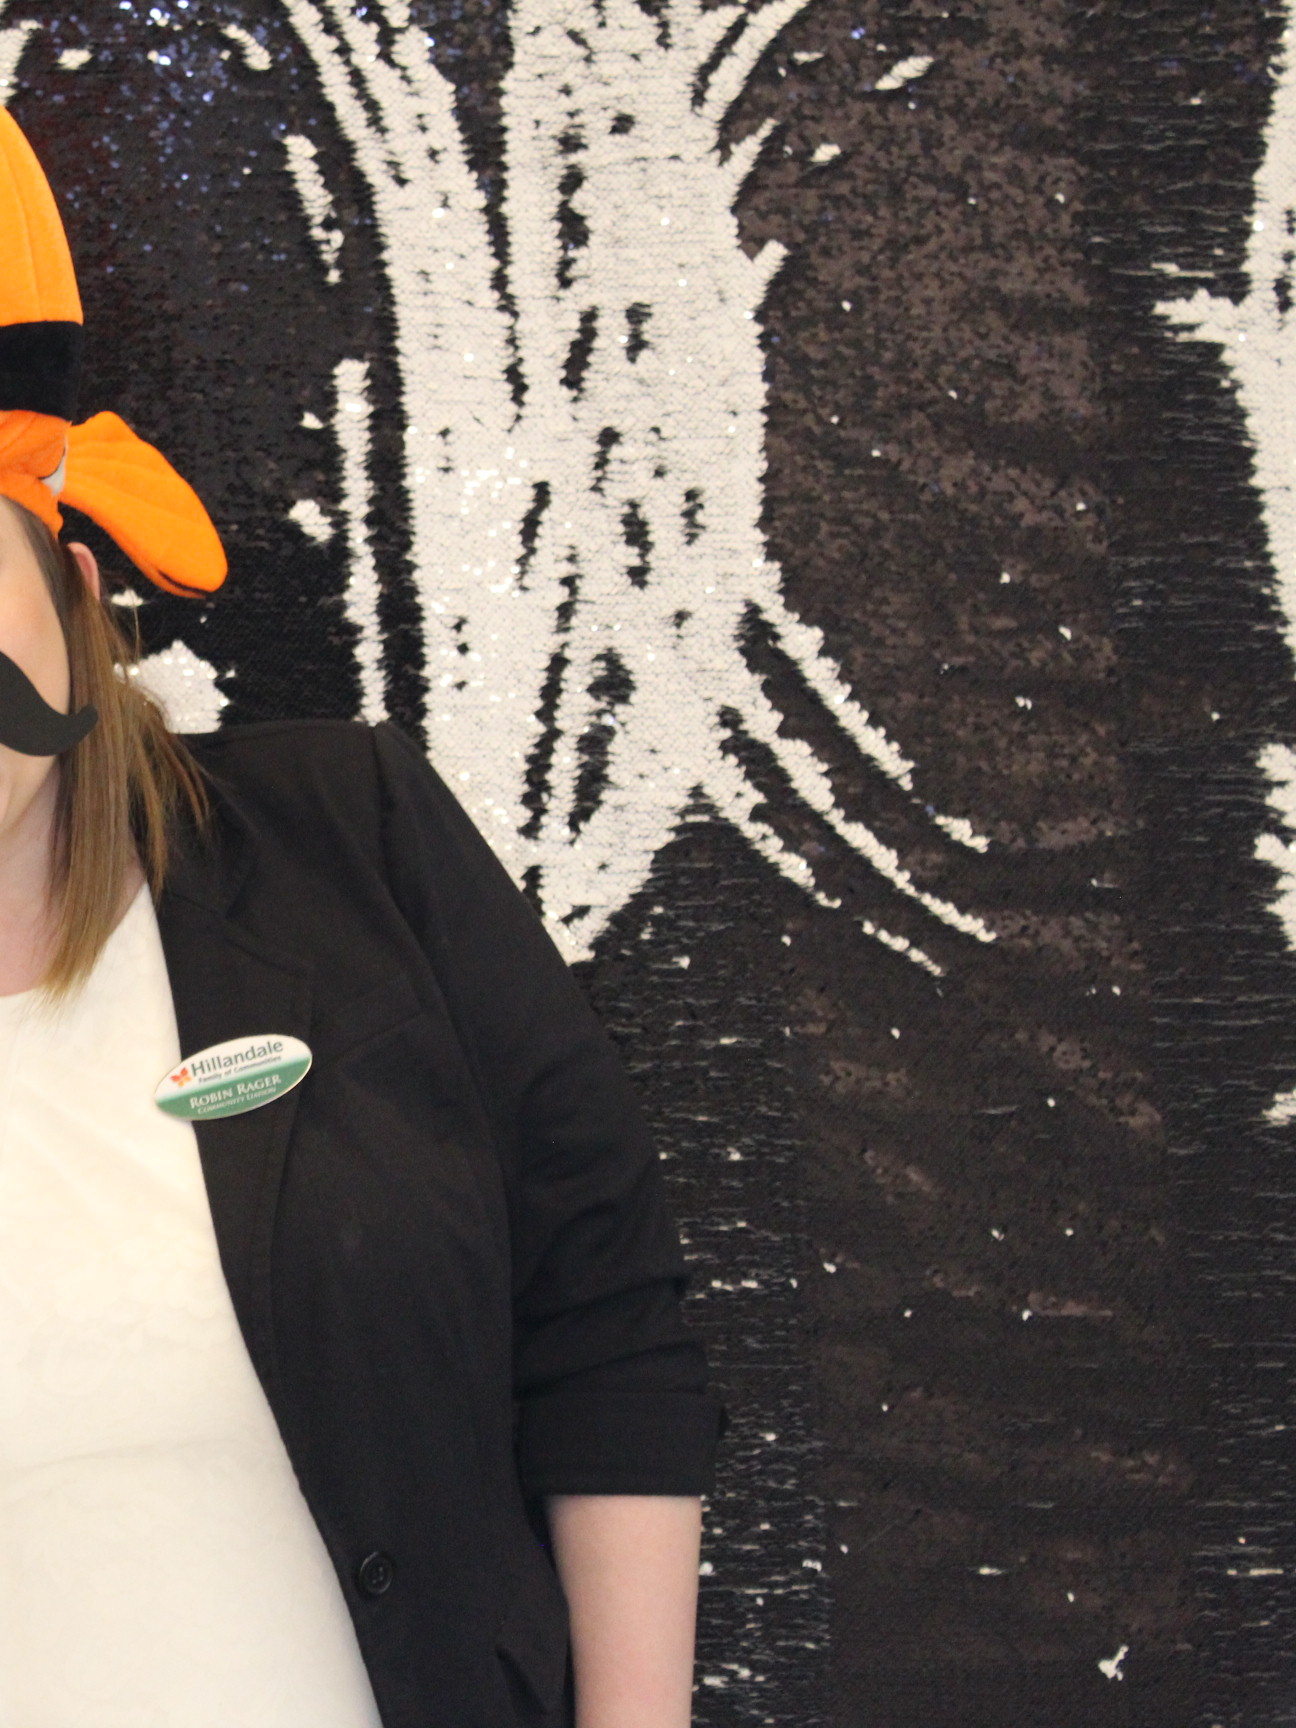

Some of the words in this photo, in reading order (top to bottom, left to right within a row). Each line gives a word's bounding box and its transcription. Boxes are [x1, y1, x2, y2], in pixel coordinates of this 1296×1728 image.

[191, 1041, 284, 1076] Hillandale
[189, 1086, 233, 1109] ROBIN
[237, 1074, 282, 1096] RAGER
[198, 1071, 222, 1084] Family
